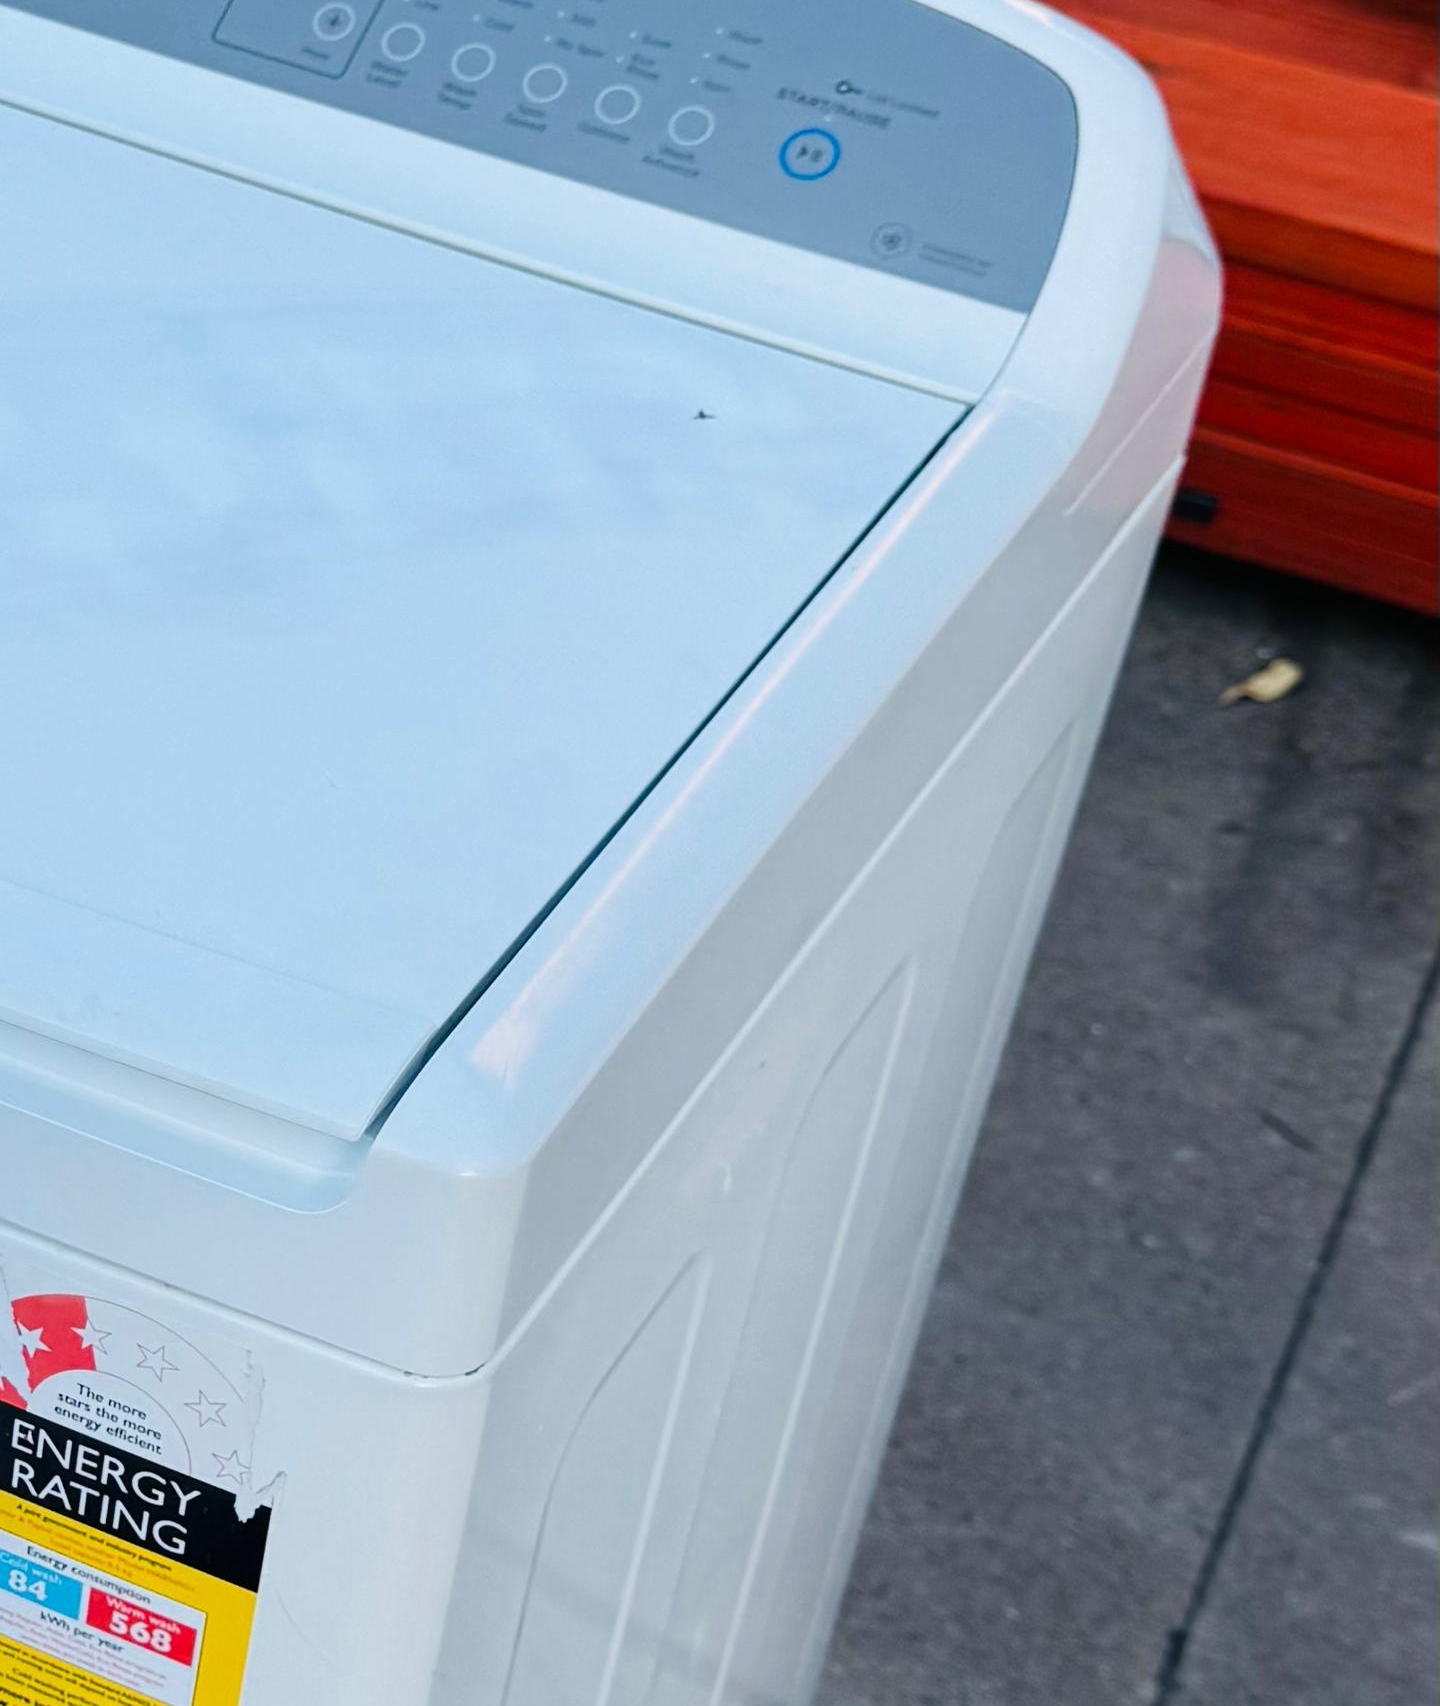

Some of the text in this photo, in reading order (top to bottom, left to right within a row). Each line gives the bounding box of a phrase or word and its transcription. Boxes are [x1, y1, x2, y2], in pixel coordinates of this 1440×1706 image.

[58, 1392, 162, 1440] stars the more
[77, 1382, 146, 1420] The more
[54, 1405, 162, 1455] energy efficient
[11, 1417, 201, 1516] ENERGY
[11, 1458, 188, 1555] RATING
[8, 1569, 48, 1601] 84
[27, 1546, 151, 1604] Energy consumption
[40, 1610, 125, 1653] kWh per year
[105, 1595, 181, 1635] Warm wash
[108, 1610, 172, 1653] 568
